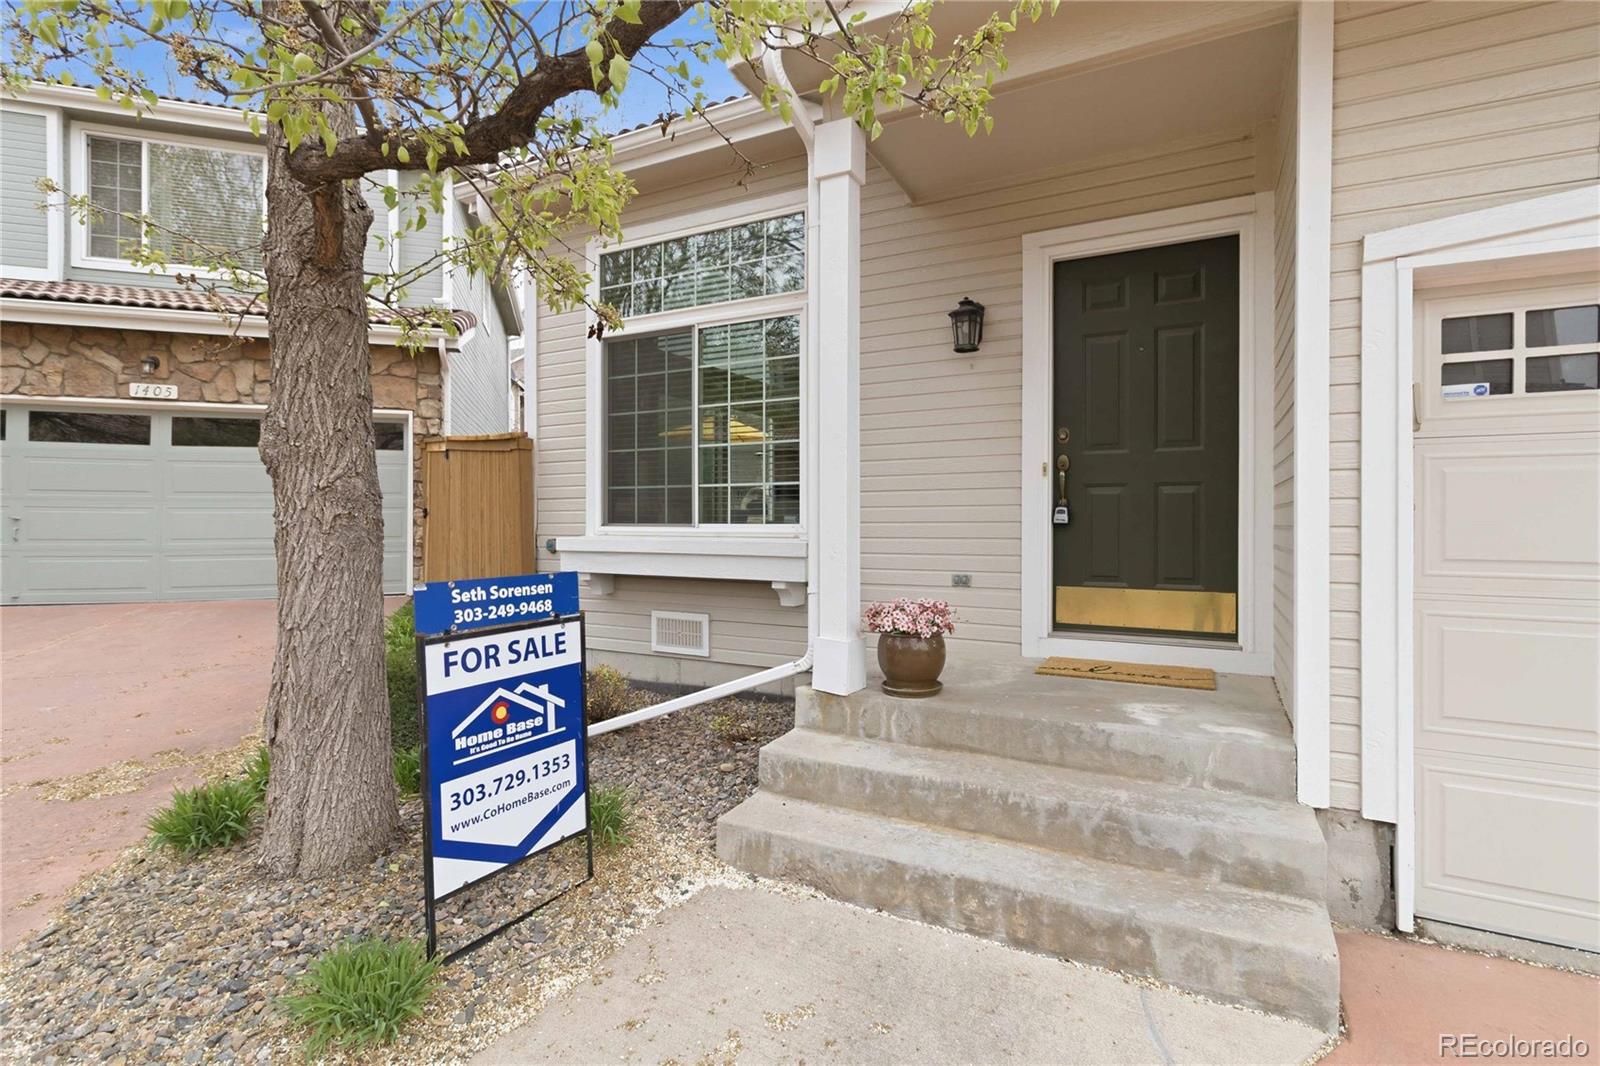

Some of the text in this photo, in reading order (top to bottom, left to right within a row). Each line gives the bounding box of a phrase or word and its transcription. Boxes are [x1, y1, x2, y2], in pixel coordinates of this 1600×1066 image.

[134, 384, 173, 397] 1405
[451, 583, 553, 603] Seth Sorensen
[454, 599, 553, 624] 303-249-9468
[443, 632, 567, 678] FOR SALE
[455, 716, 544, 751] Home Base
[498, 738, 506, 746] To
[450, 753, 571, 812] 303.729.1353
[450, 779, 572, 833] www.CoHomeBase.com
